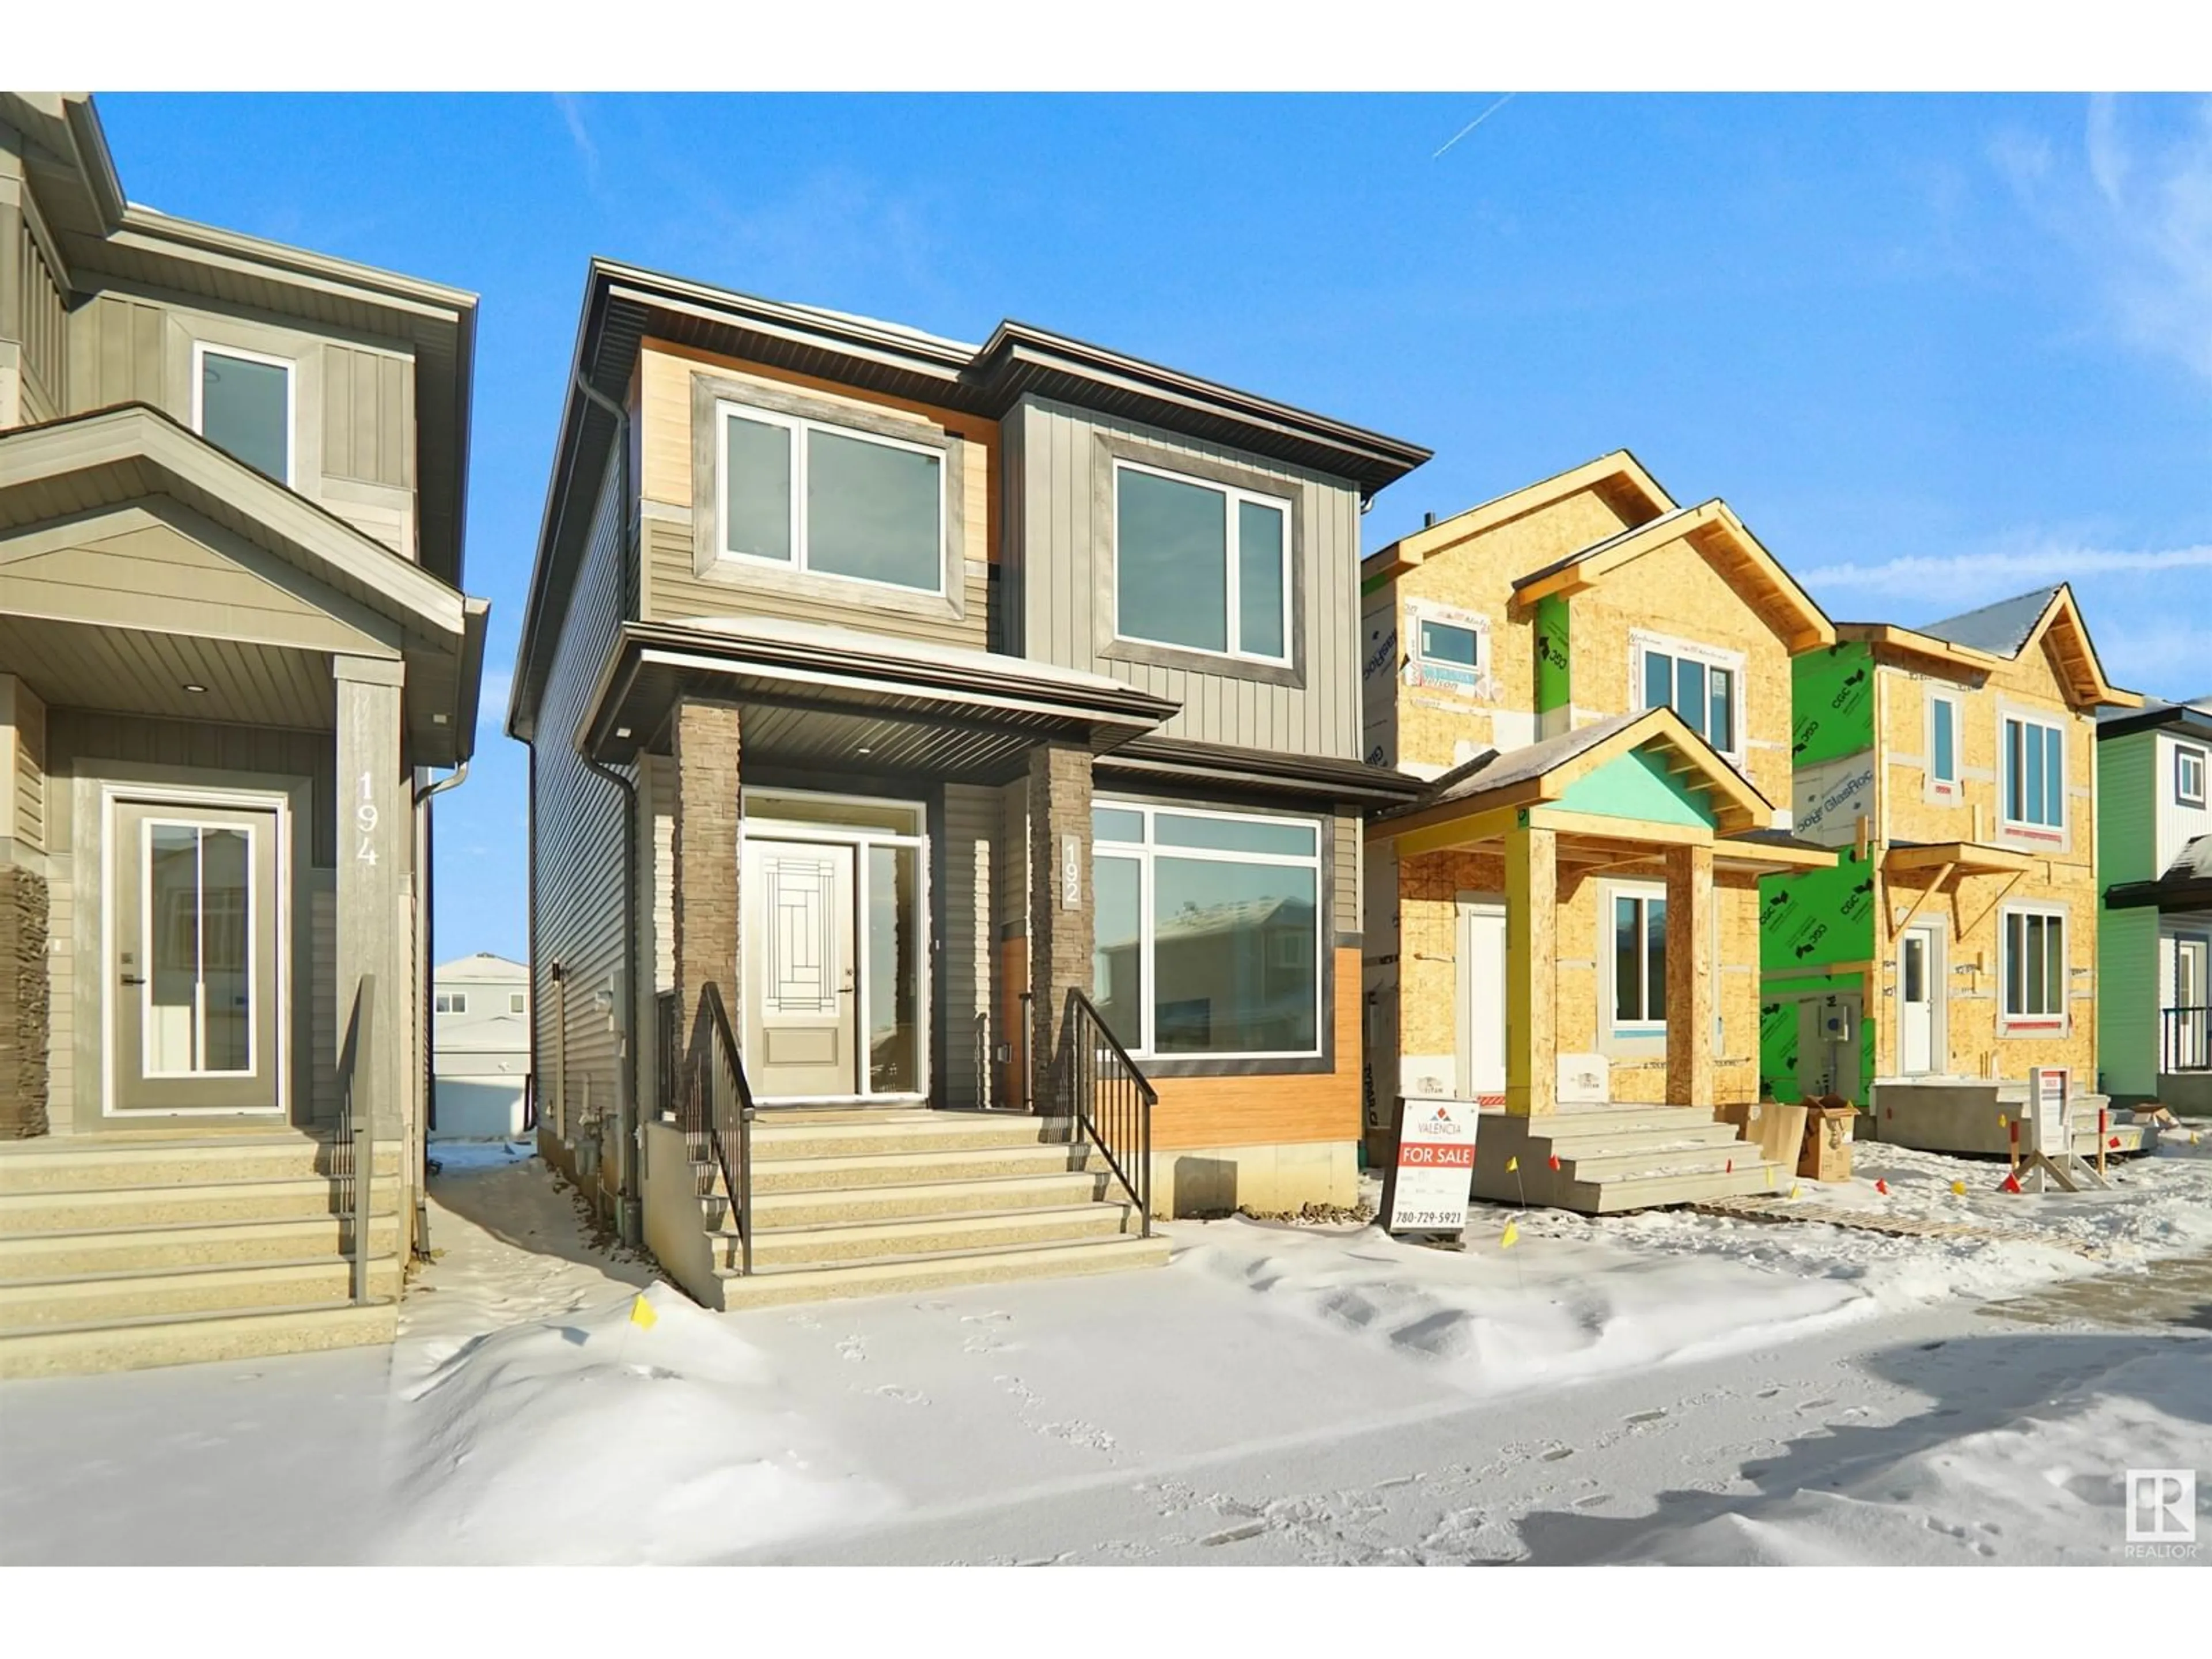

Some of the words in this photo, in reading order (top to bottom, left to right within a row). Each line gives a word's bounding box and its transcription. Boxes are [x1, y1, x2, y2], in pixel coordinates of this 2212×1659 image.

[1550, 649, 1567, 669] CGC
[1832, 687, 1851, 709] CGC
[1801, 721, 1819, 742] CGC
[1824, 770, 1873, 812] GlassRoc
[357, 771, 380, 866] 194
[1066, 842, 1078, 903] 192
[1840, 893, 1859, 915] CGC
[1760, 906, 1776, 926] CGC
[1809, 923, 1828, 944] CGC
[1418, 1122, 1461, 1135] VALENCIA
[1403, 1147, 1434, 1163] FOR
[1436, 1148, 1471, 1164] SALE
[1396, 1211, 1461, 1224] 780-729-5921
